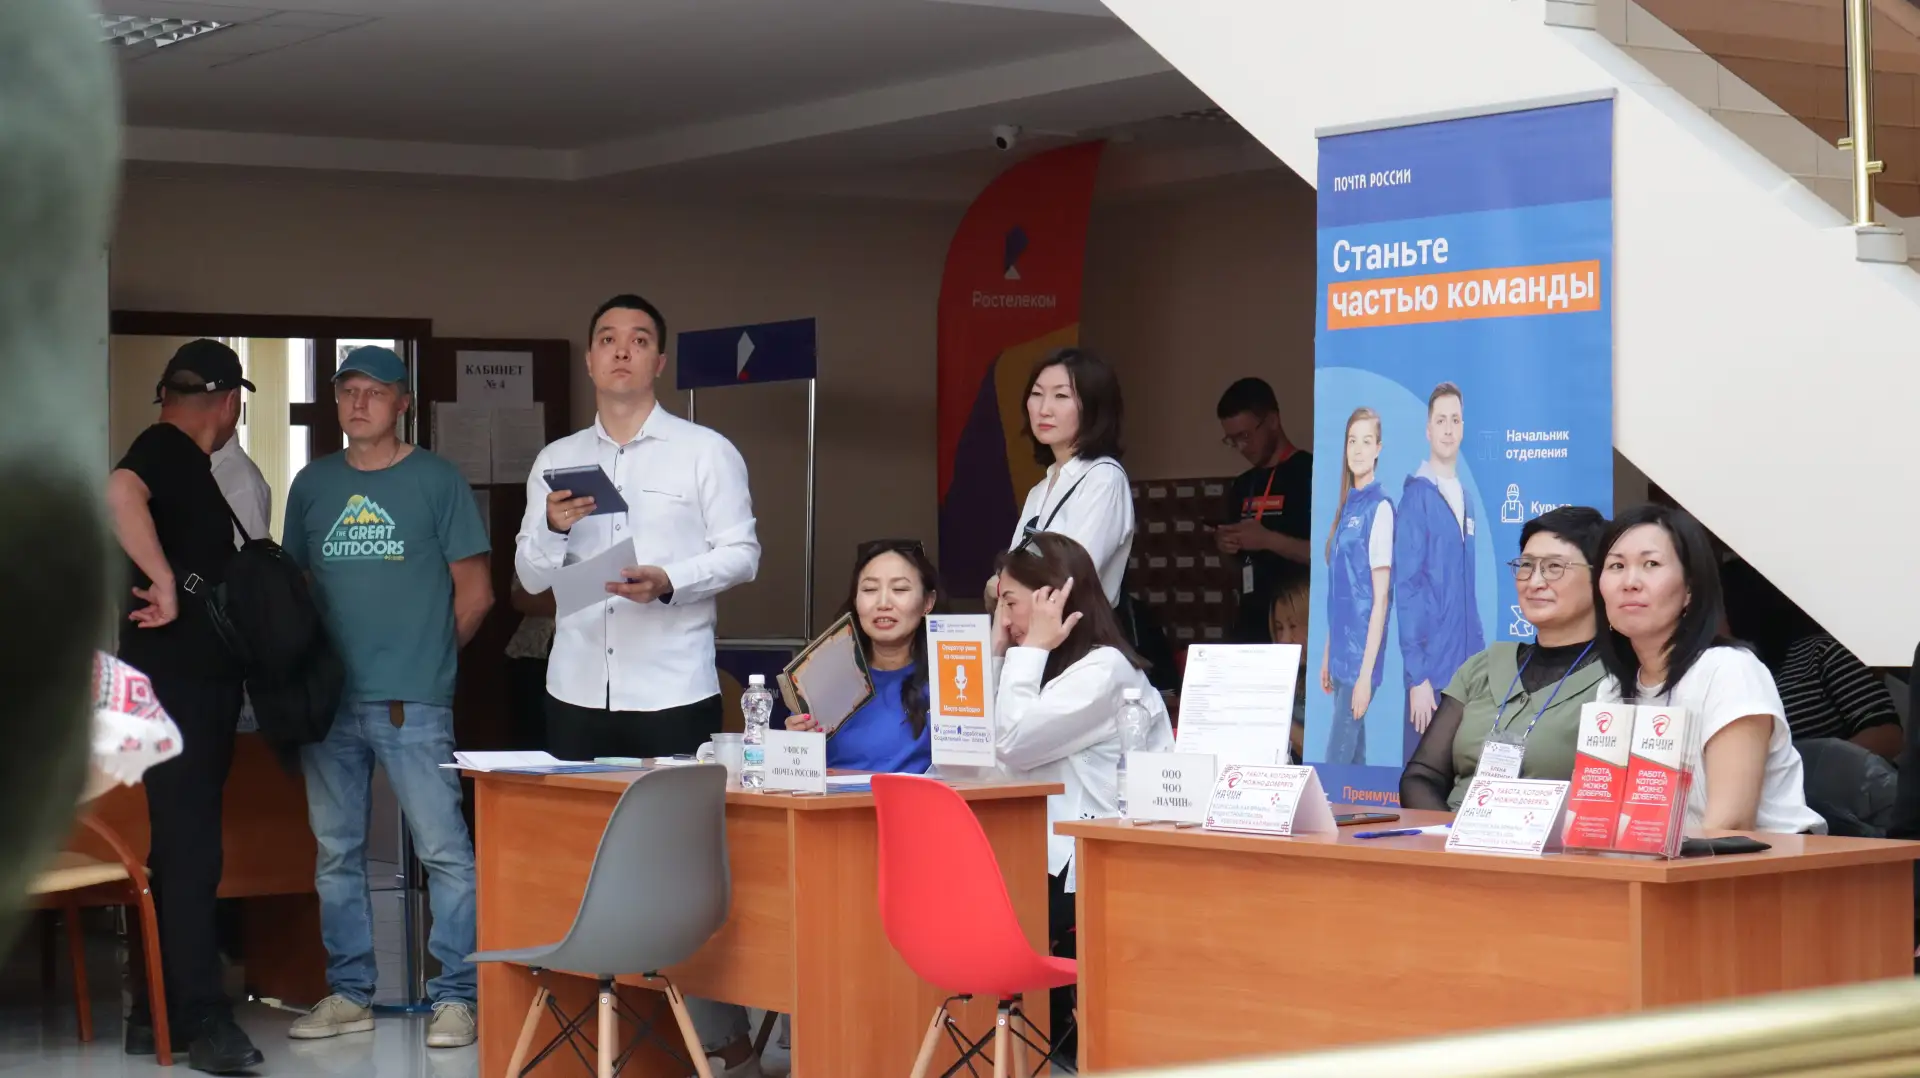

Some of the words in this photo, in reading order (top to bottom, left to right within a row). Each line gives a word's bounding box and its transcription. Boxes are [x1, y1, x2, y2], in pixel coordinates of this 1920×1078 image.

[1334, 174, 1367, 192] ПОЧТА
[1370, 168, 1411, 188] РОССИИ
[1333, 237, 1449, 273] Станьте
[972, 290, 1056, 308] Ростелеком
[1332, 283, 1438, 317] частью
[1447, 271, 1594, 309] команды
[465, 364, 525, 375] КАБИНЕТ
[484, 379, 497, 389] №
[499, 379, 505, 389] 4
[1506, 429, 1570, 442] Начальник
[1505, 448, 1568, 461] отделения
[348, 525, 396, 540] GREAT
[322, 540, 404, 556] OUTDOORS
[1586, 735, 1617, 748] НАЧИН
[1641, 738, 1674, 751] НАЧИН
[801, 747, 809, 755] РК
[792, 757, 801, 765] АО
[1161, 769, 1182, 779] ООО
[1584, 767, 1611, 777] РАБОТА,
[1638, 770, 1667, 780] РАБОТА,
[1581, 774, 1612, 783] КОТОРОЙ
[1635, 778, 1668, 786] КОТОРОЙ
[1162, 783, 1182, 793] ЧОО
[1583, 782, 1608, 790] МОЖНО
[1343, 786, 1400, 806] Преимущ
[1523, 788, 1553, 797] КОТОРОЙ
[1576, 789, 1611, 798] ДОВЕРЯТЬ
[1631, 792, 1667, 801] ДОВЕРЯТЬ
[1152, 797, 1193, 807] «НАЧИН»
[1519, 797, 1550, 806] ДОВЕРЯТЬ
